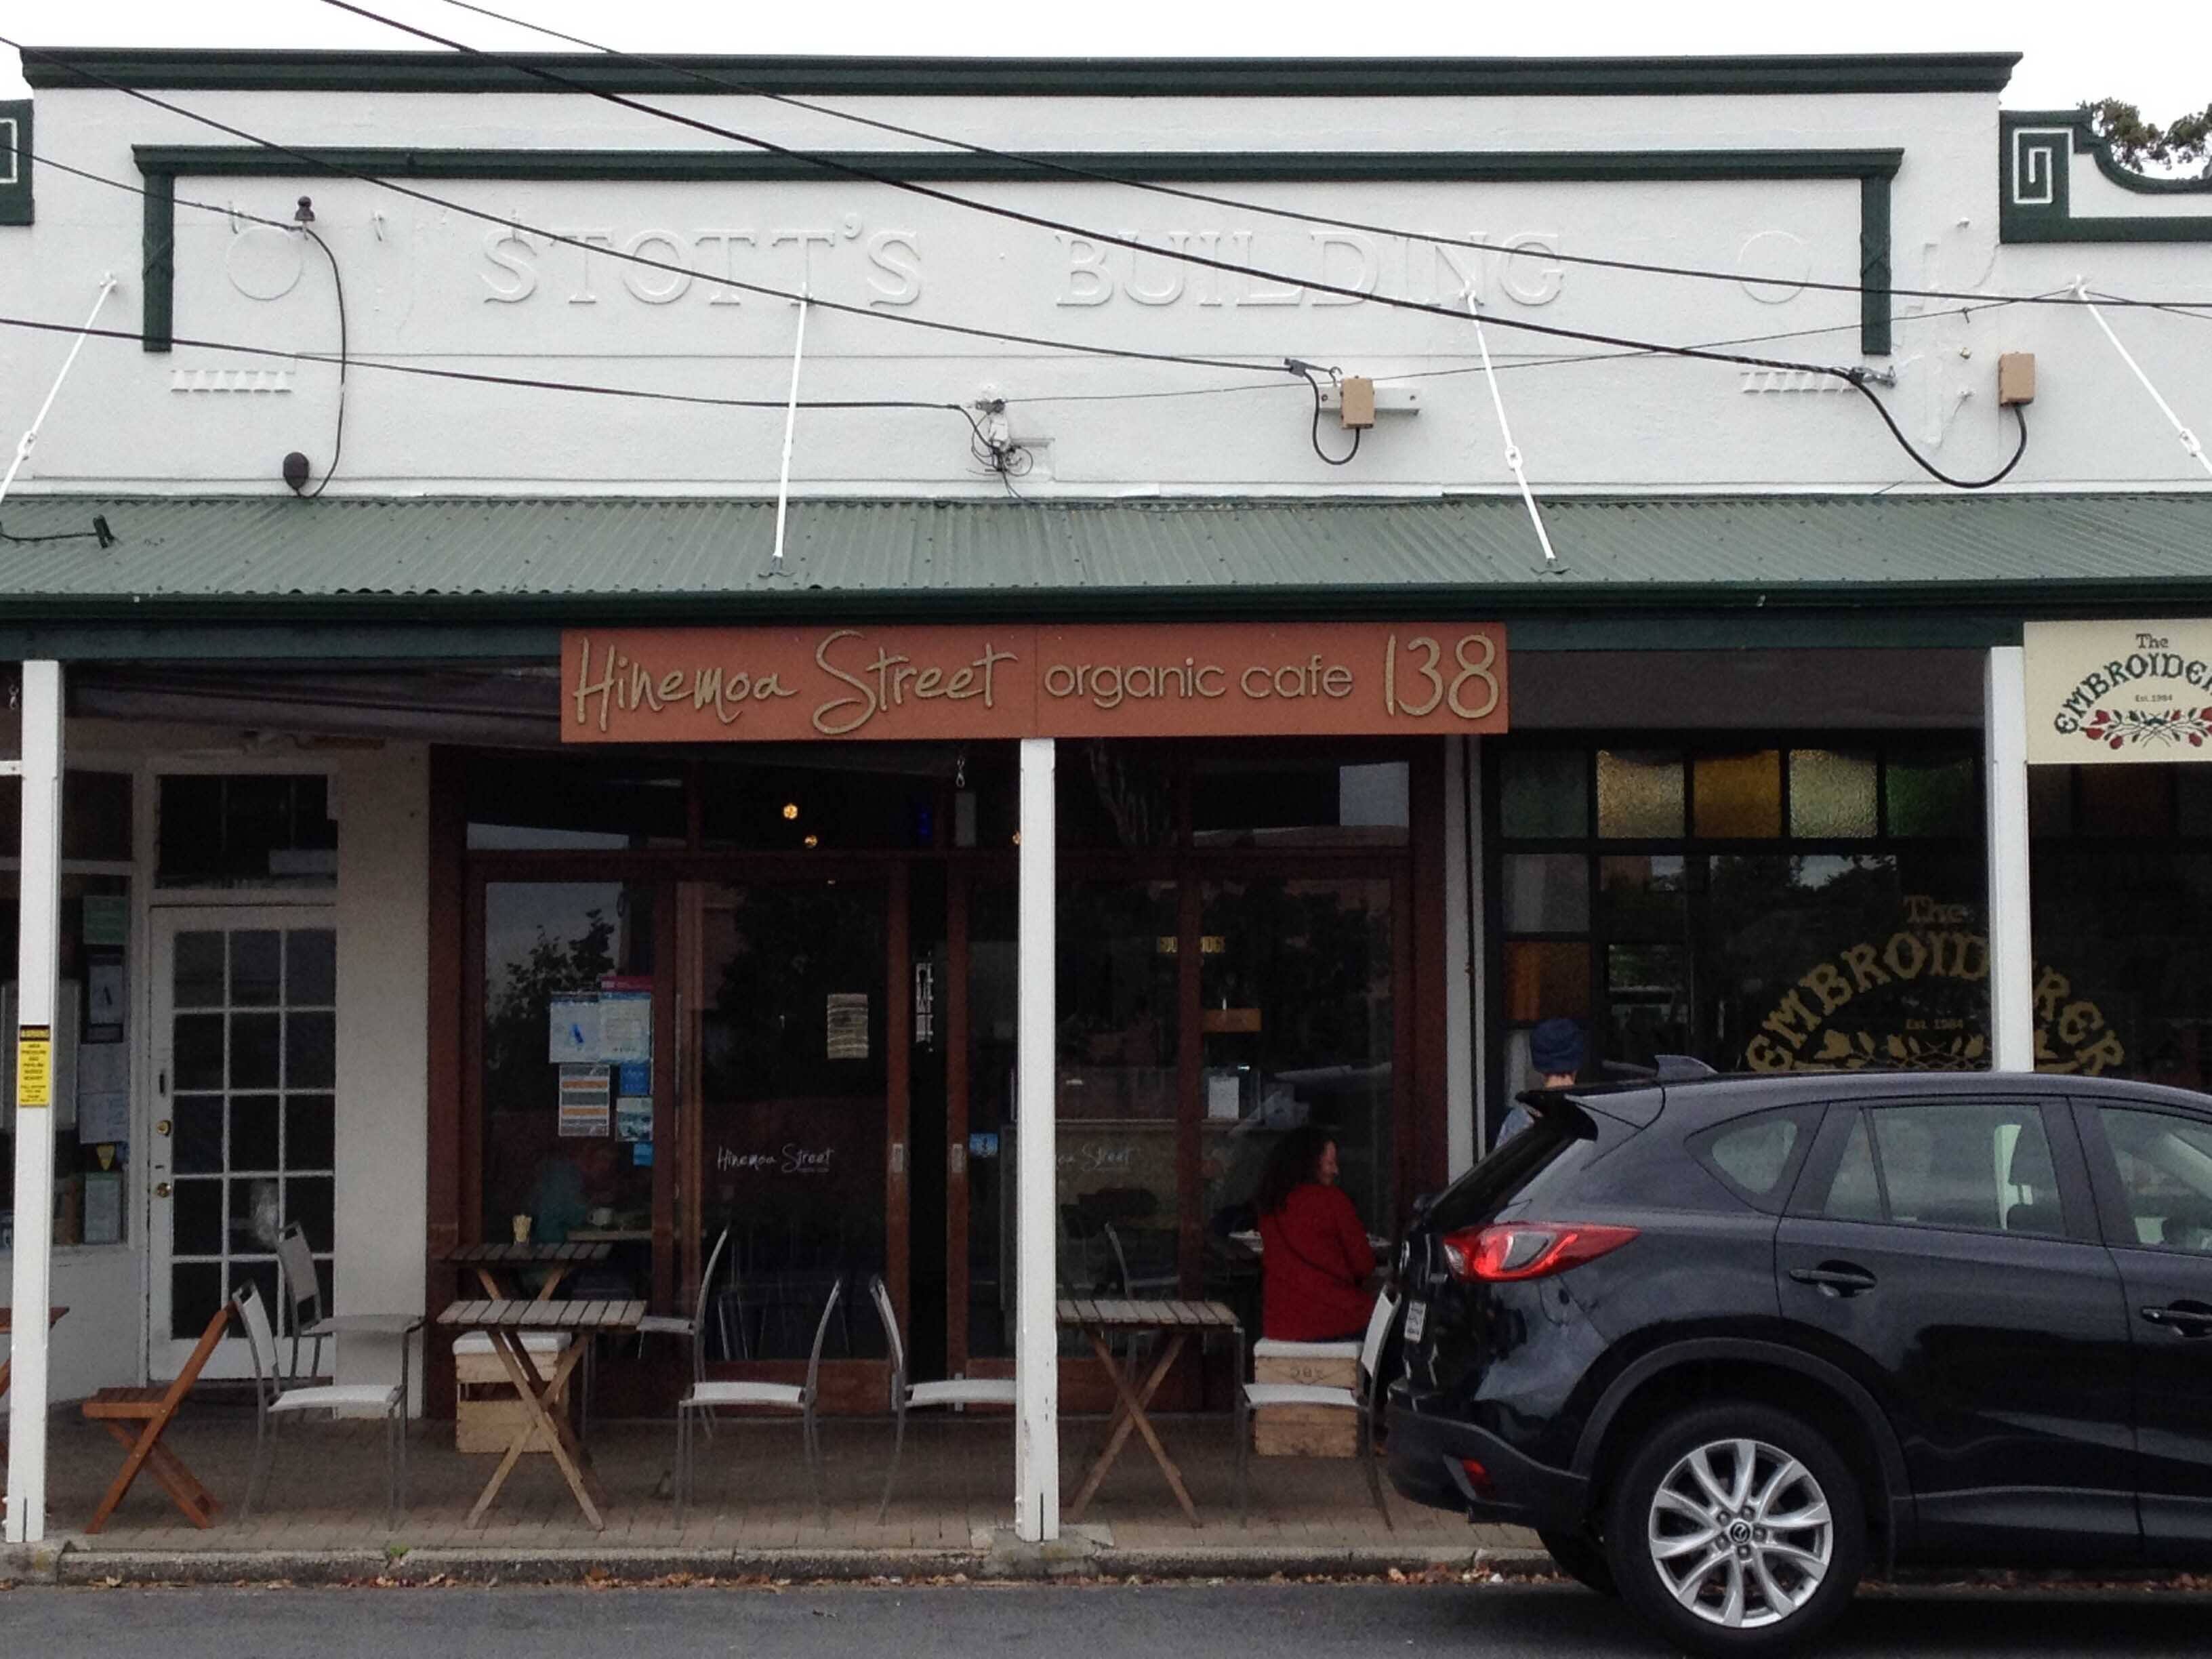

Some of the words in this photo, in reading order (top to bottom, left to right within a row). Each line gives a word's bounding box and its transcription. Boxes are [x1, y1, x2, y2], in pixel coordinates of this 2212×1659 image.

[480, 211, 922, 306] STOTT'S
[1054, 231, 1564, 307] BUILDING
[2135, 633, 2169, 649] The
[573, 636, 800, 732] Hinemoa
[813, 629, 1018, 735] Street
[1044, 656, 1227, 709] organic
[1240, 653, 1353, 699] cafe
[1385, 632, 1500, 720] 138
[1902, 895, 1965, 924] The
[1745, 931, 2125, 1076] EMBROIDRER
[717, 1145, 777, 1171] Hinemoa
[781, 1143, 835, 1172] Street
